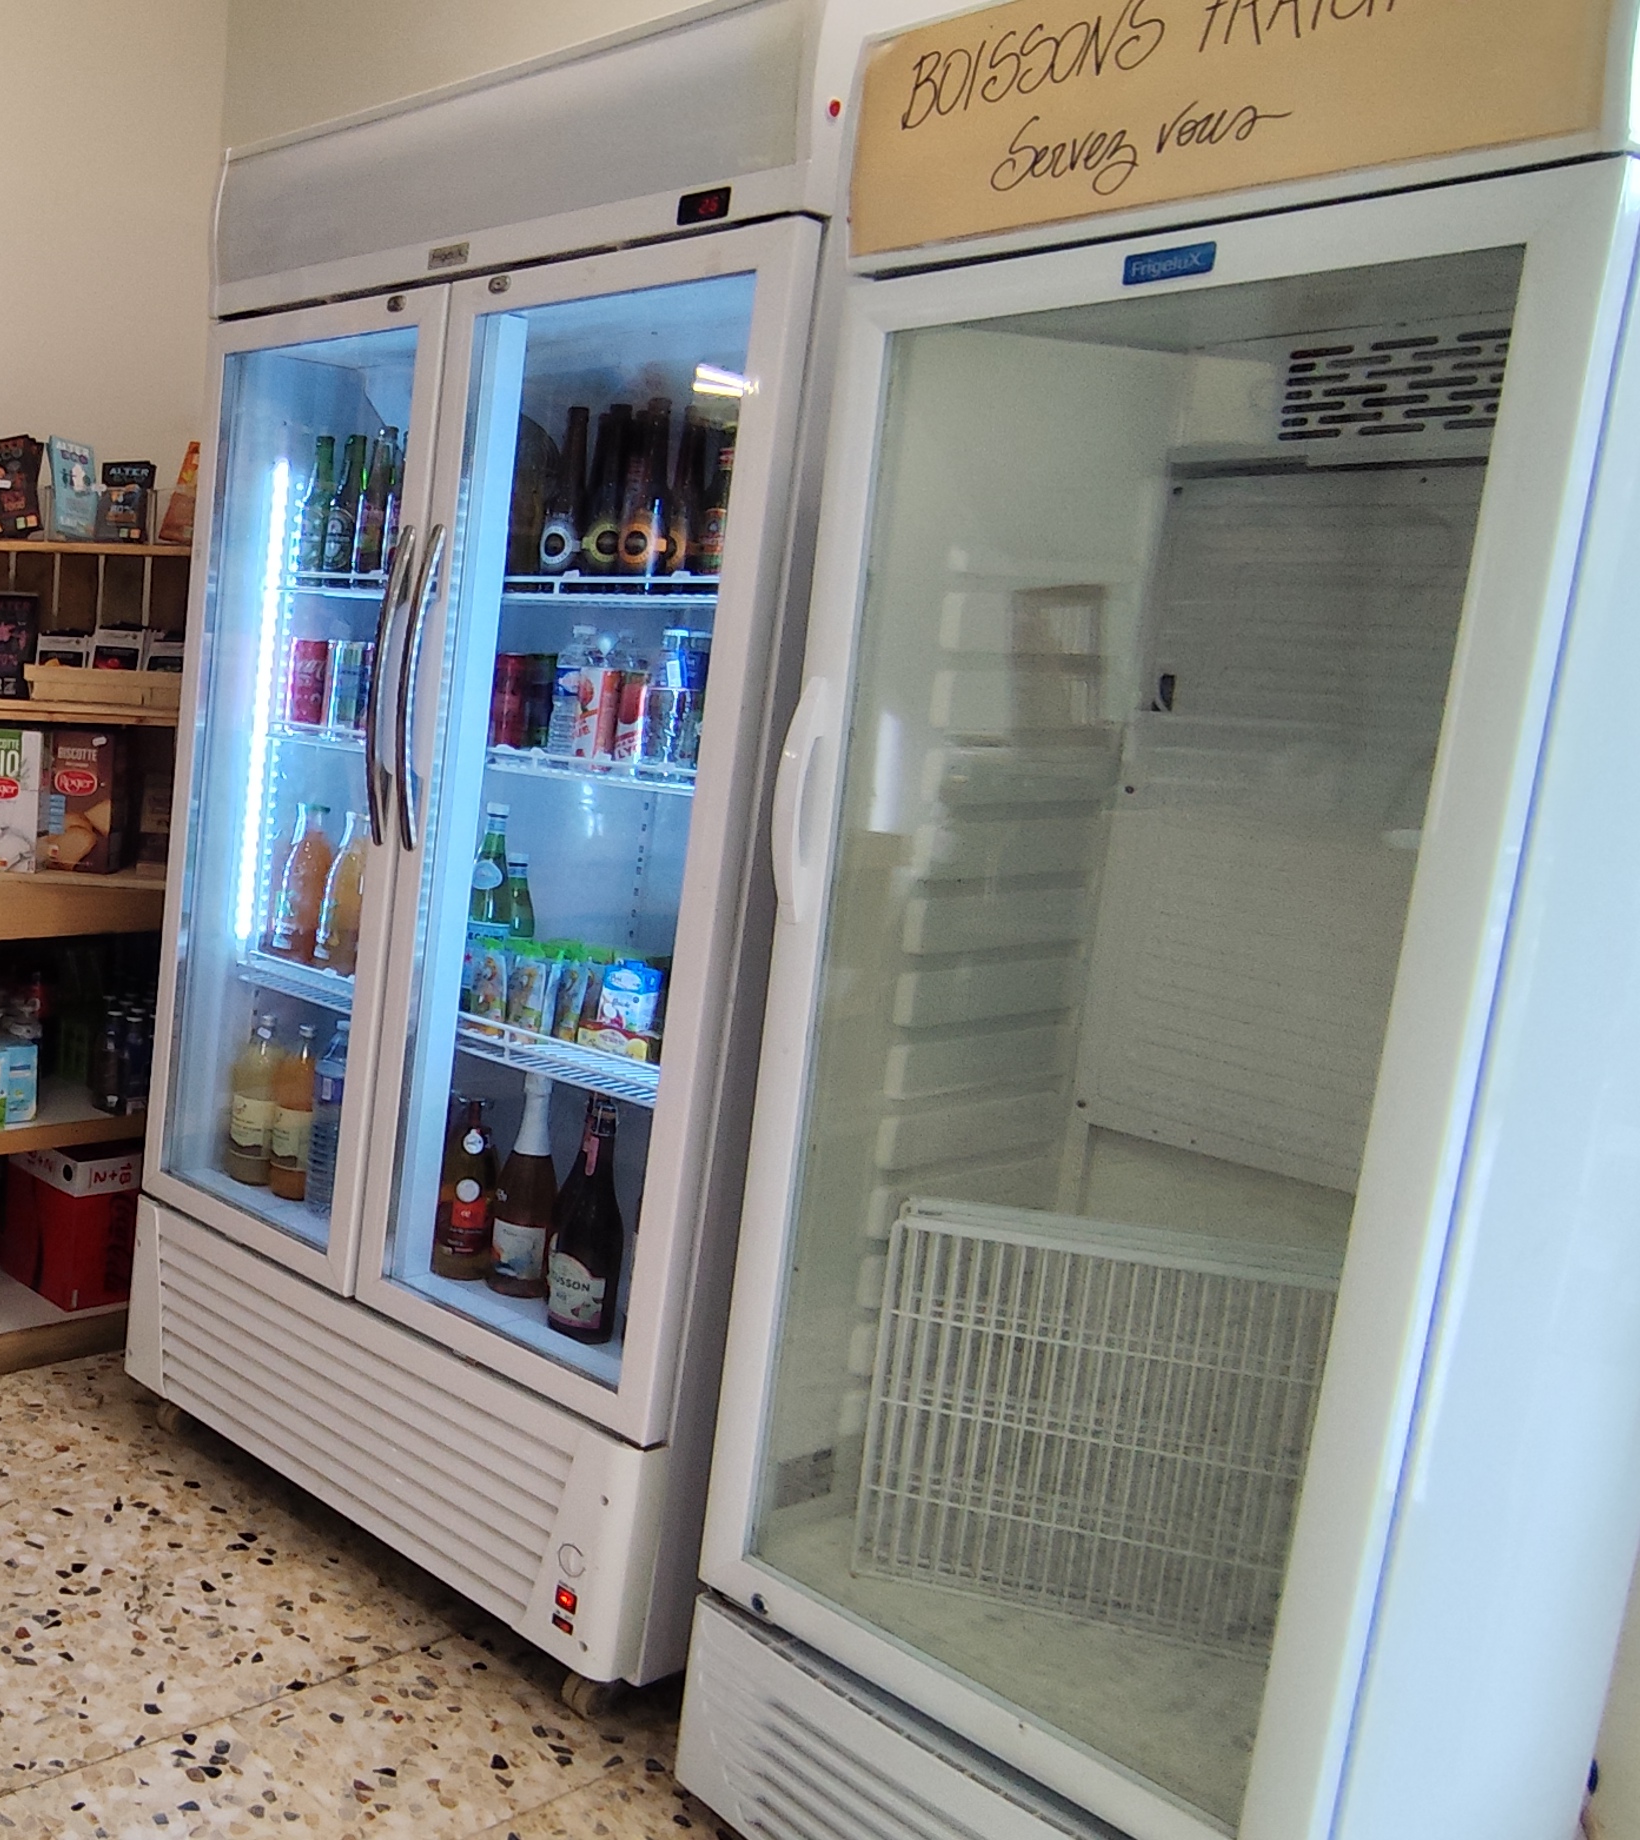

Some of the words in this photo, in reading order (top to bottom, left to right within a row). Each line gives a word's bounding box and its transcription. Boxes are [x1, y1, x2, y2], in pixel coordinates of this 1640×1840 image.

[990, 115, 1139, 196] Servez
[109, 466, 150, 477] ALTER
[57, 746, 98, 762] BISCOTTE
